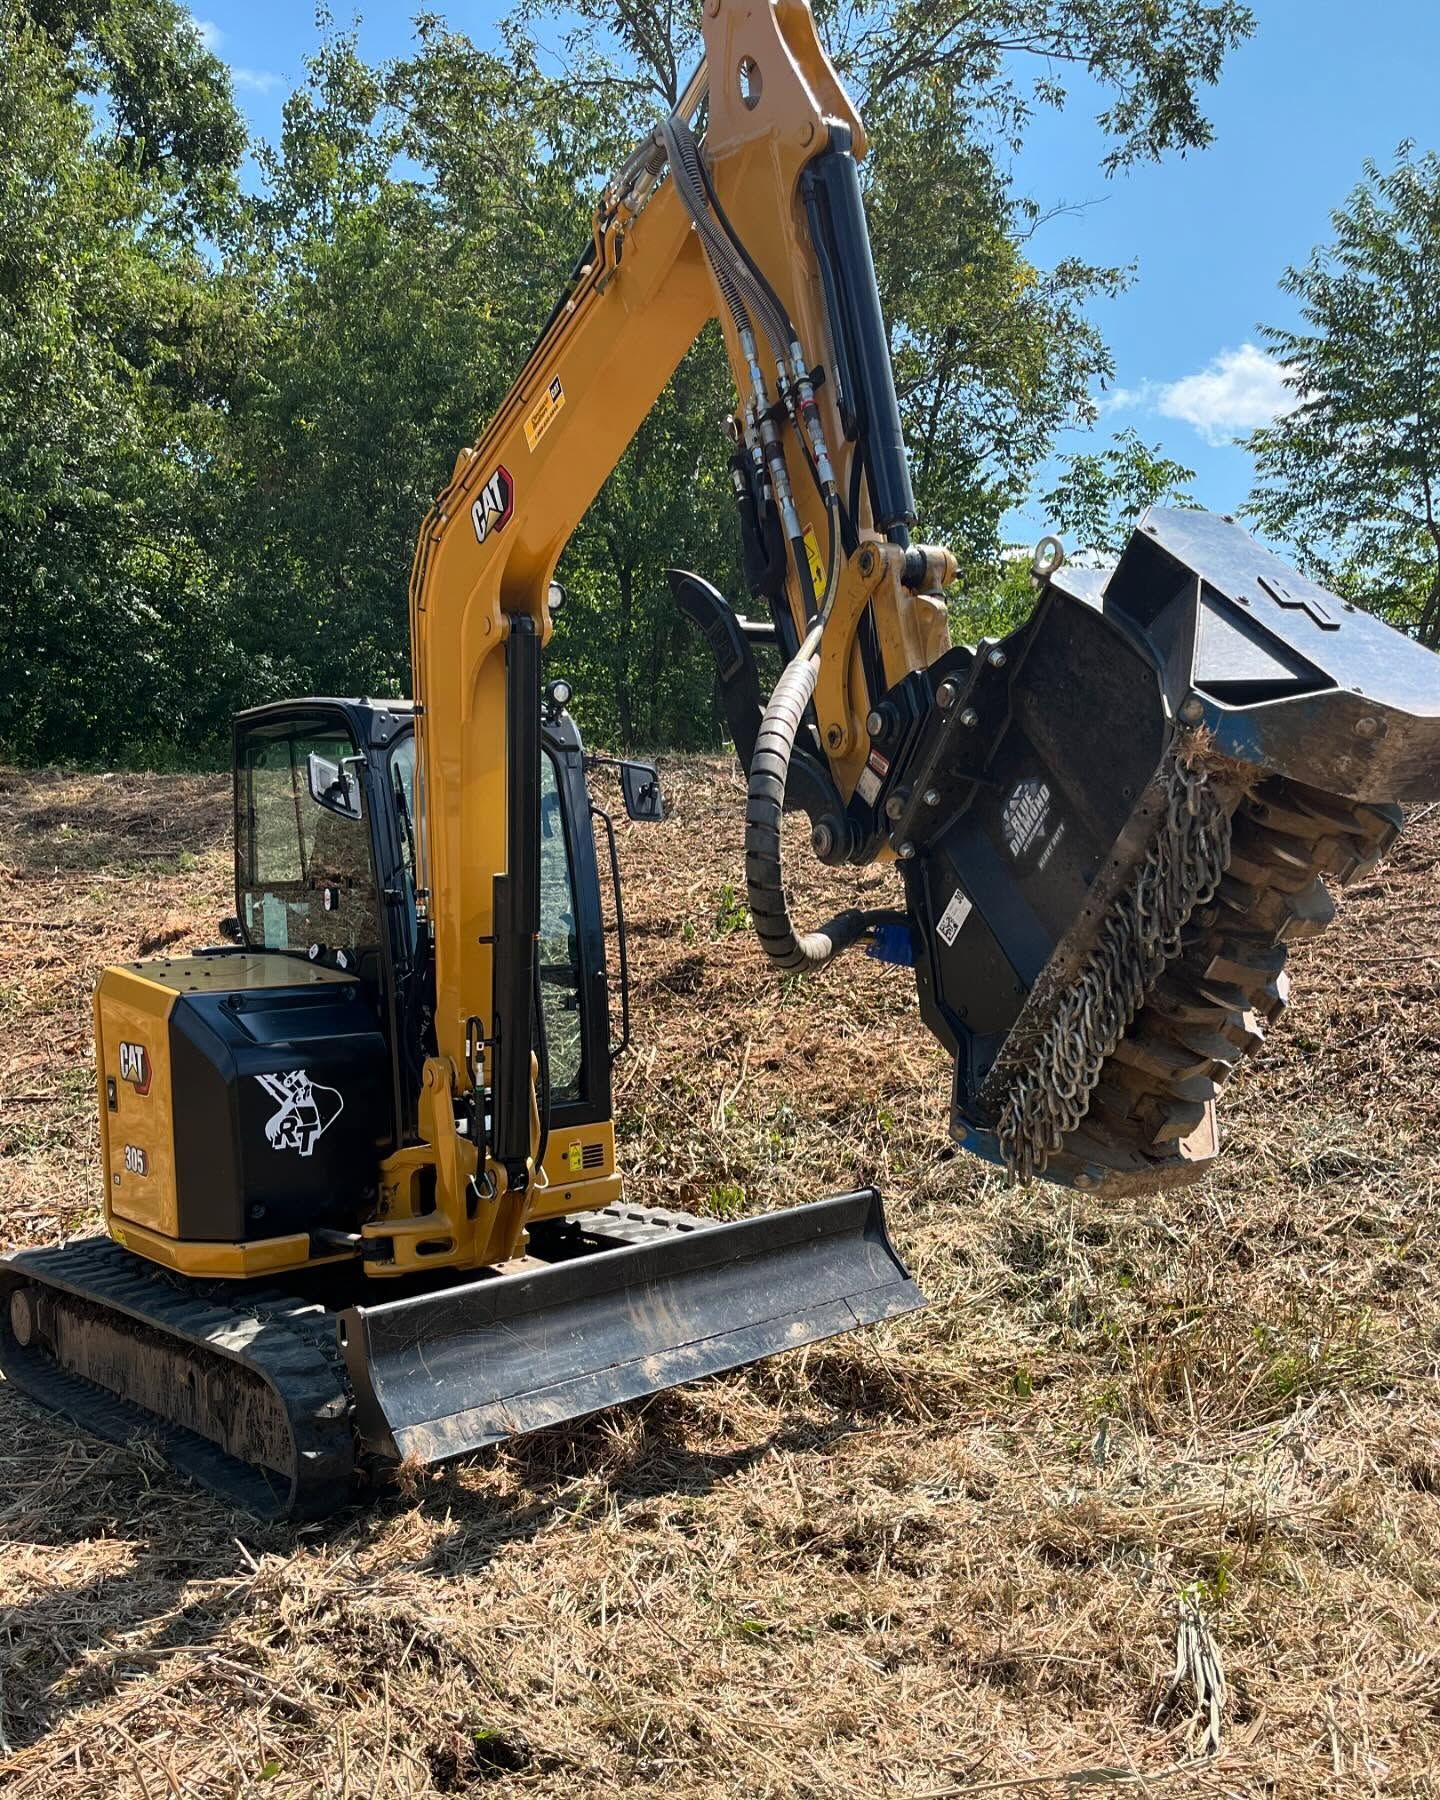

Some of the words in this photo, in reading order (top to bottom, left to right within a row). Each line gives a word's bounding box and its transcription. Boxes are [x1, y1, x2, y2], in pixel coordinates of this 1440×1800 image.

[471, 470, 504, 543] CAT
[1009, 784, 1050, 857] DIAMOND
[1010, 791, 1033, 833] BLUE
[1038, 845, 1053, 870] HEAVY
[1051, 823, 1065, 847] DUTY
[119, 1042, 144, 1083] CAT
[272, 1116, 320, 1156] RT
[124, 1145, 144, 1173] 305
